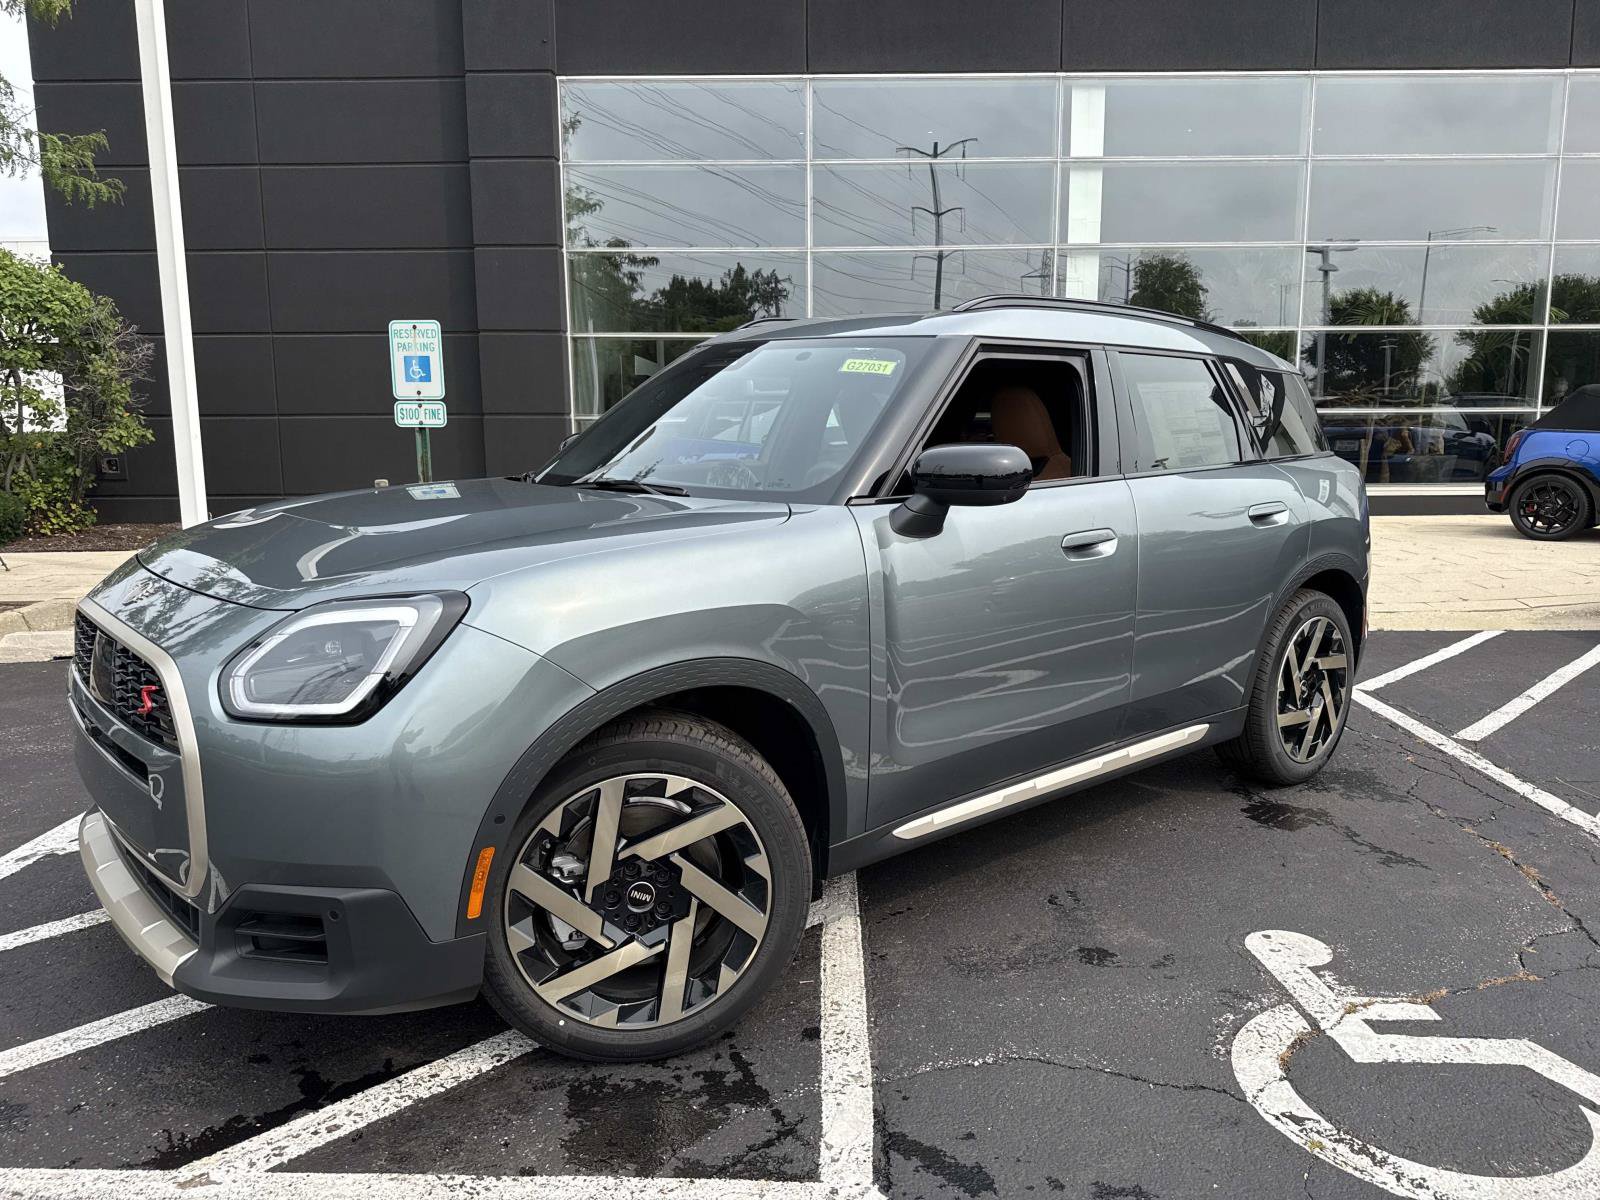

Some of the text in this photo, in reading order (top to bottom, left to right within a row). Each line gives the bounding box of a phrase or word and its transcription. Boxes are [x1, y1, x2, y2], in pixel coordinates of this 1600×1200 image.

[393, 328, 437, 339] RESERVED
[397, 342, 435, 352] PARKING
[846, 361, 889, 372] G27031
[399, 407, 442, 421] $100 FINE
[630, 889, 652, 902] MINI
